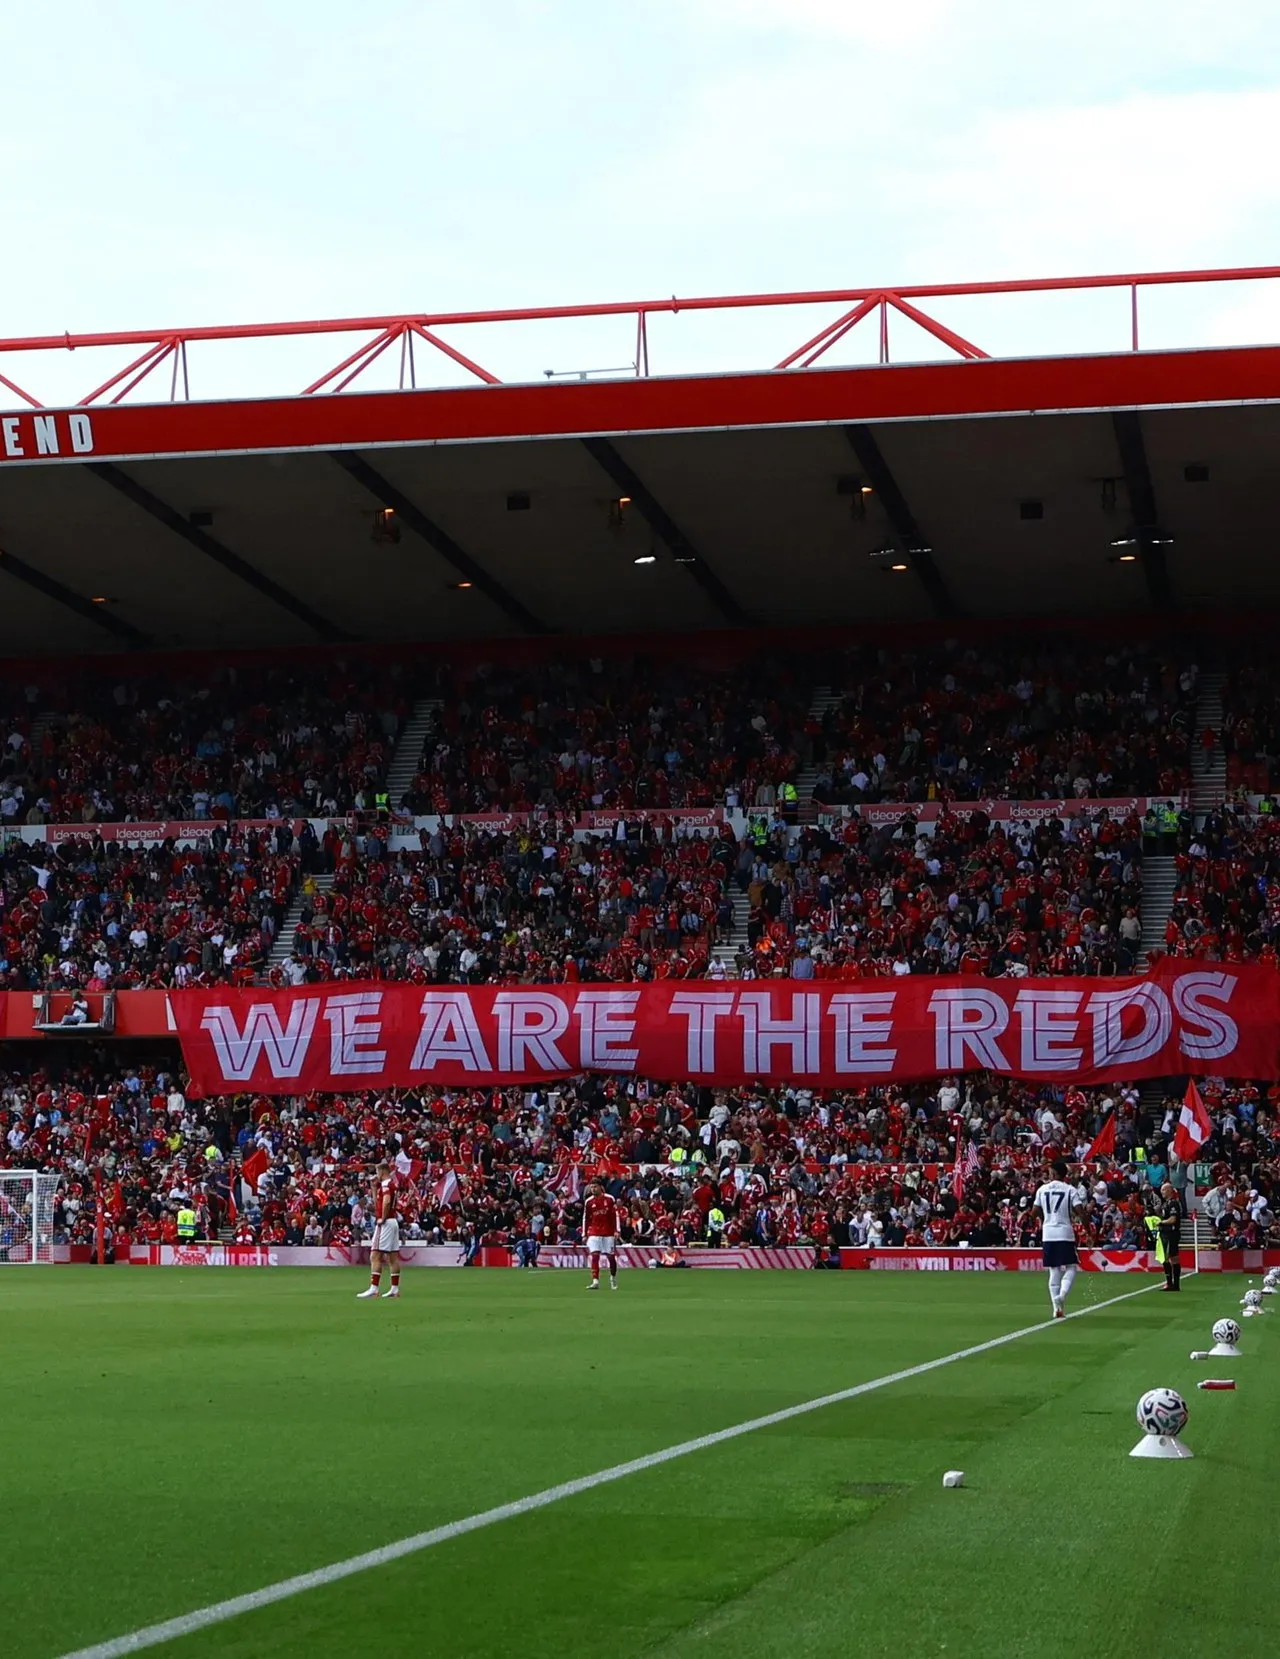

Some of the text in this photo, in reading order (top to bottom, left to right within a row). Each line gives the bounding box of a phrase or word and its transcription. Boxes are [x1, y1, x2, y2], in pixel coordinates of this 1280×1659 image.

[2, 414, 93, 456] END
[869, 809, 906, 823] Ideag
[1009, 807, 1059, 818] Ideagen
[53, 829, 91, 841] Ideage
[116, 828, 160, 840] Ideagen
[179, 827, 213, 837] Ideag
[200, 971, 1238, 1081] WE ARE THE REDS
[1044, 1192, 1065, 1214] 17
